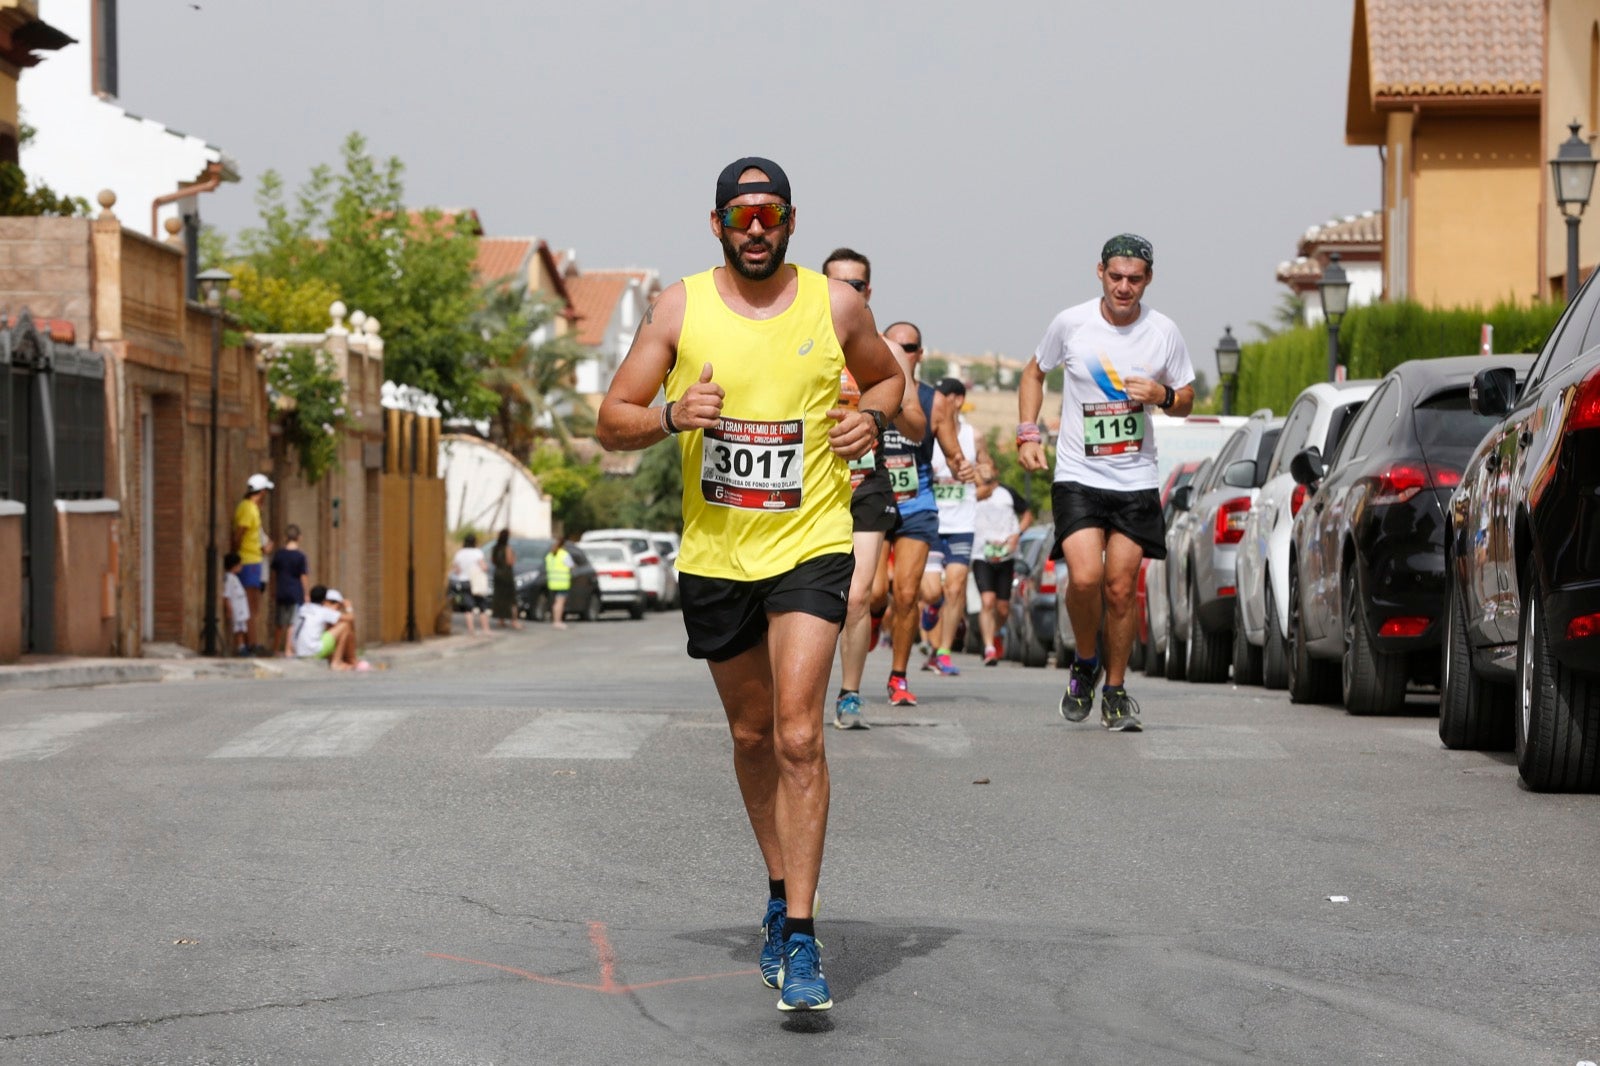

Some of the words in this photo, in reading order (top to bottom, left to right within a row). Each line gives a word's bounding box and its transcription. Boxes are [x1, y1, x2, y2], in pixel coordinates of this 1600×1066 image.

[725, 421, 742, 432] GRAN
[744, 423, 768, 435] PREMIO
[770, 424, 778, 435] DE
[780, 423, 797, 434] FONDO
[1095, 416, 1137, 439] 119
[715, 445, 796, 478] 3017
